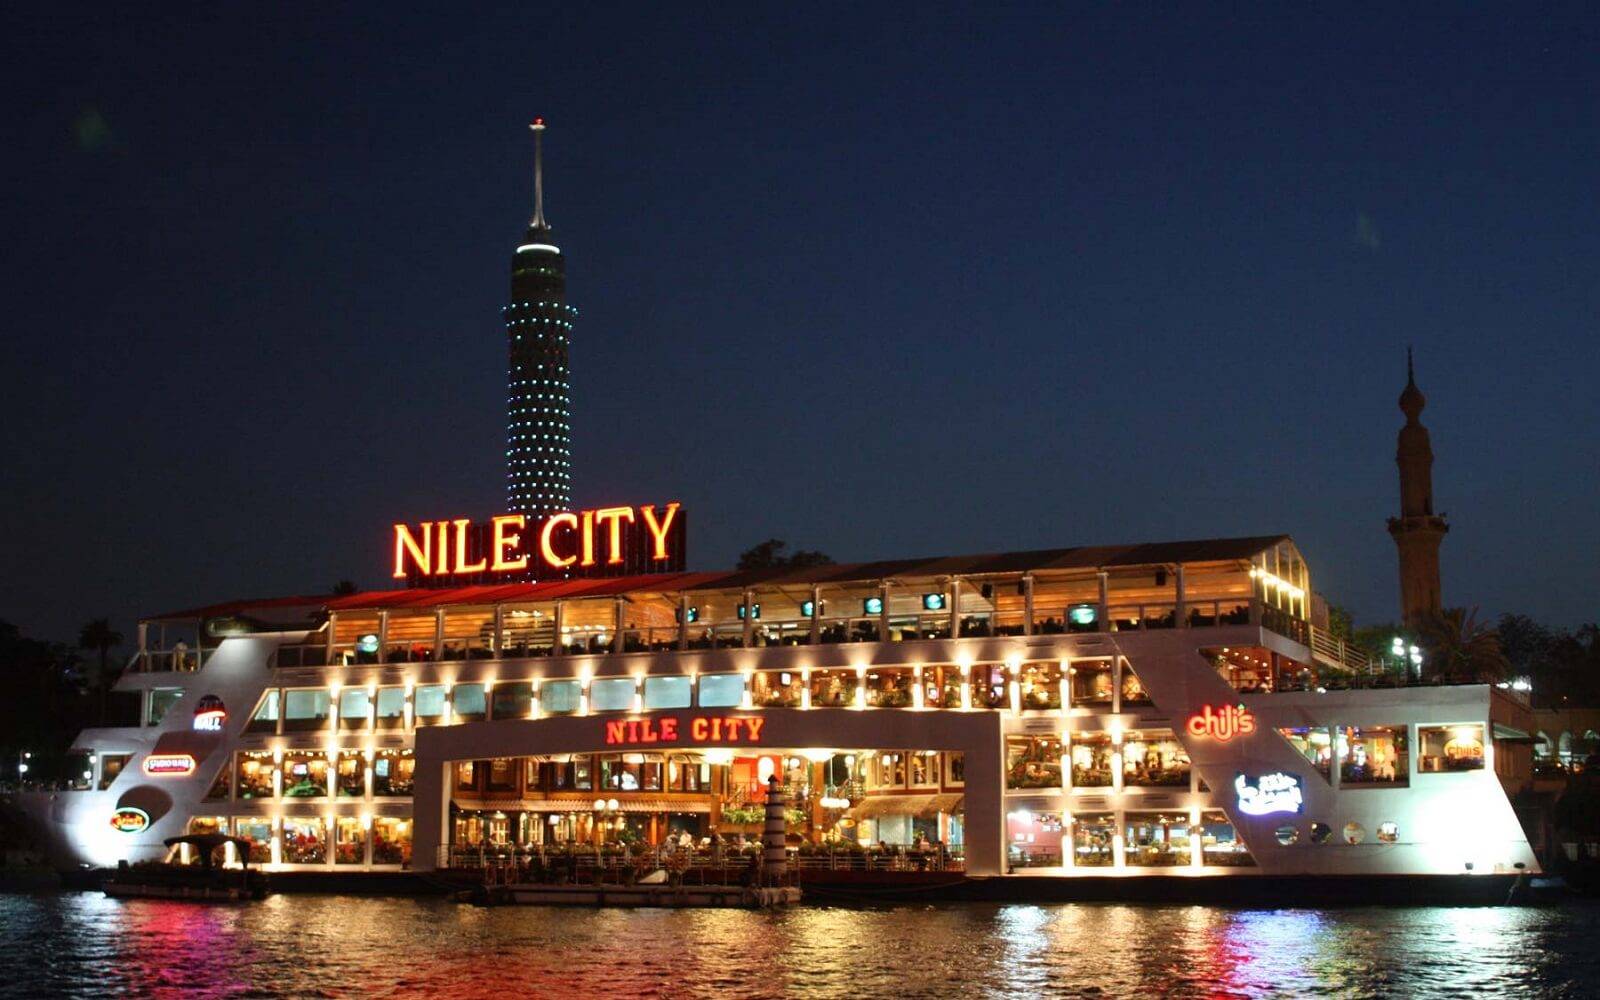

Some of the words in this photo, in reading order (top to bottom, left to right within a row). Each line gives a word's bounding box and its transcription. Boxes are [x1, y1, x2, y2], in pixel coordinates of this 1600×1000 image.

[392, 515, 527, 578] NILE
[540, 502, 680, 567] CITY
[606, 718, 677, 744] NILE
[692, 718, 764, 742] CITY
[1188, 703, 1254, 741] chili's
